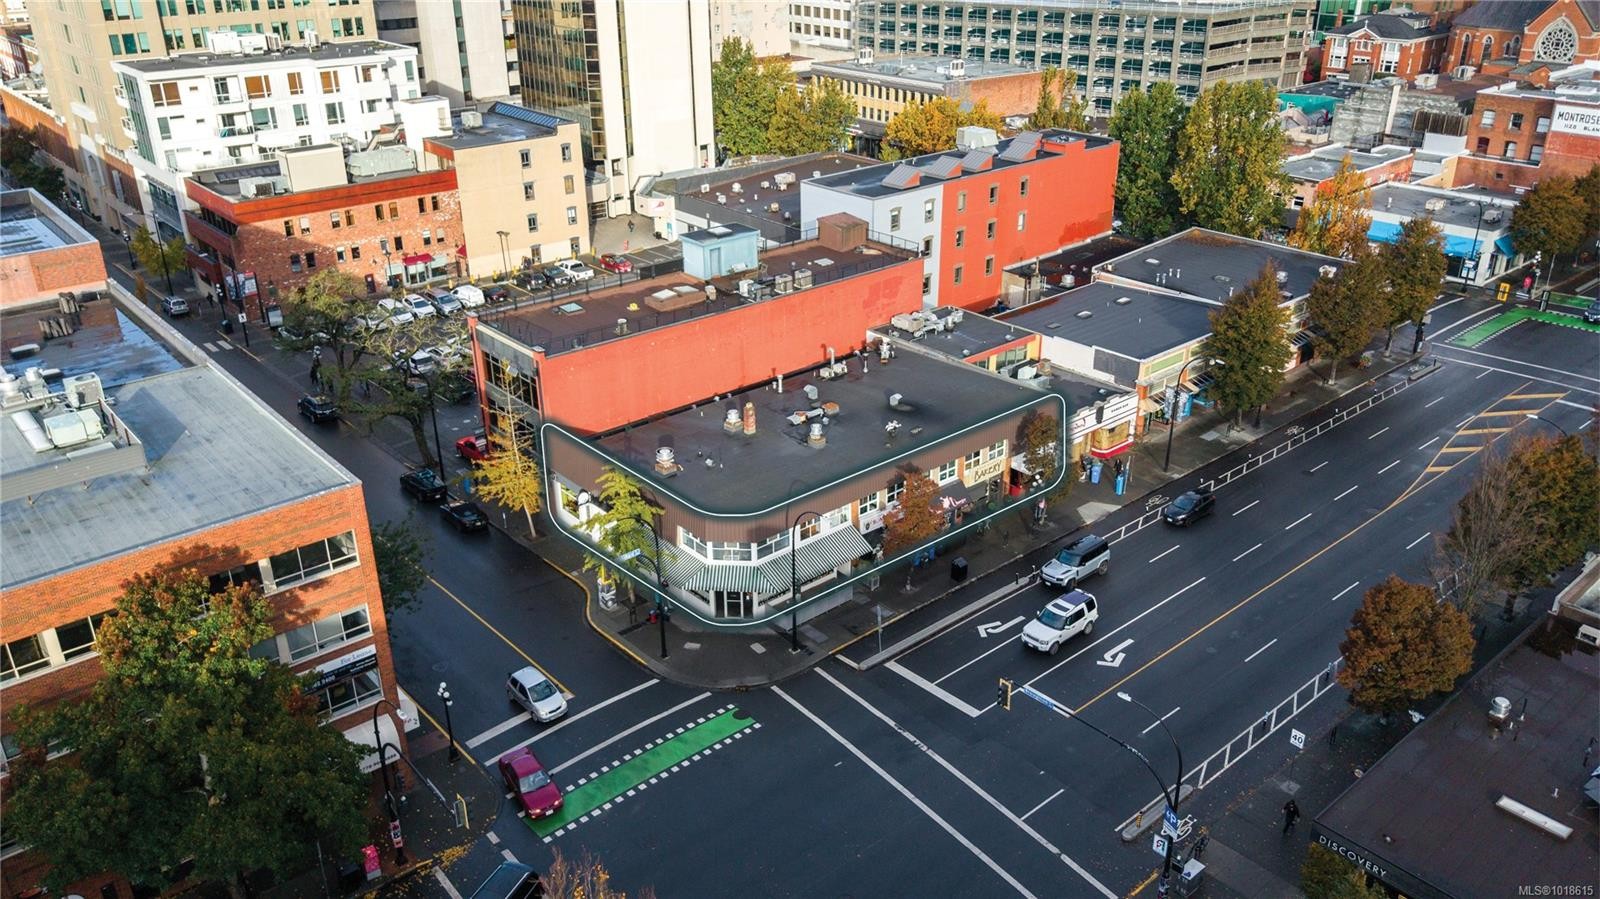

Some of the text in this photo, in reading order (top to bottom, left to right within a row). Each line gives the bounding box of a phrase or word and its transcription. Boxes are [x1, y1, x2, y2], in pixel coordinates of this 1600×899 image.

[1557, 111, 1600, 125] MONTROSE
[975, 460, 1002, 482] BAKERY
[1292, 734, 1303, 744] 40
[1319, 835, 1387, 877] DISCOVERY
